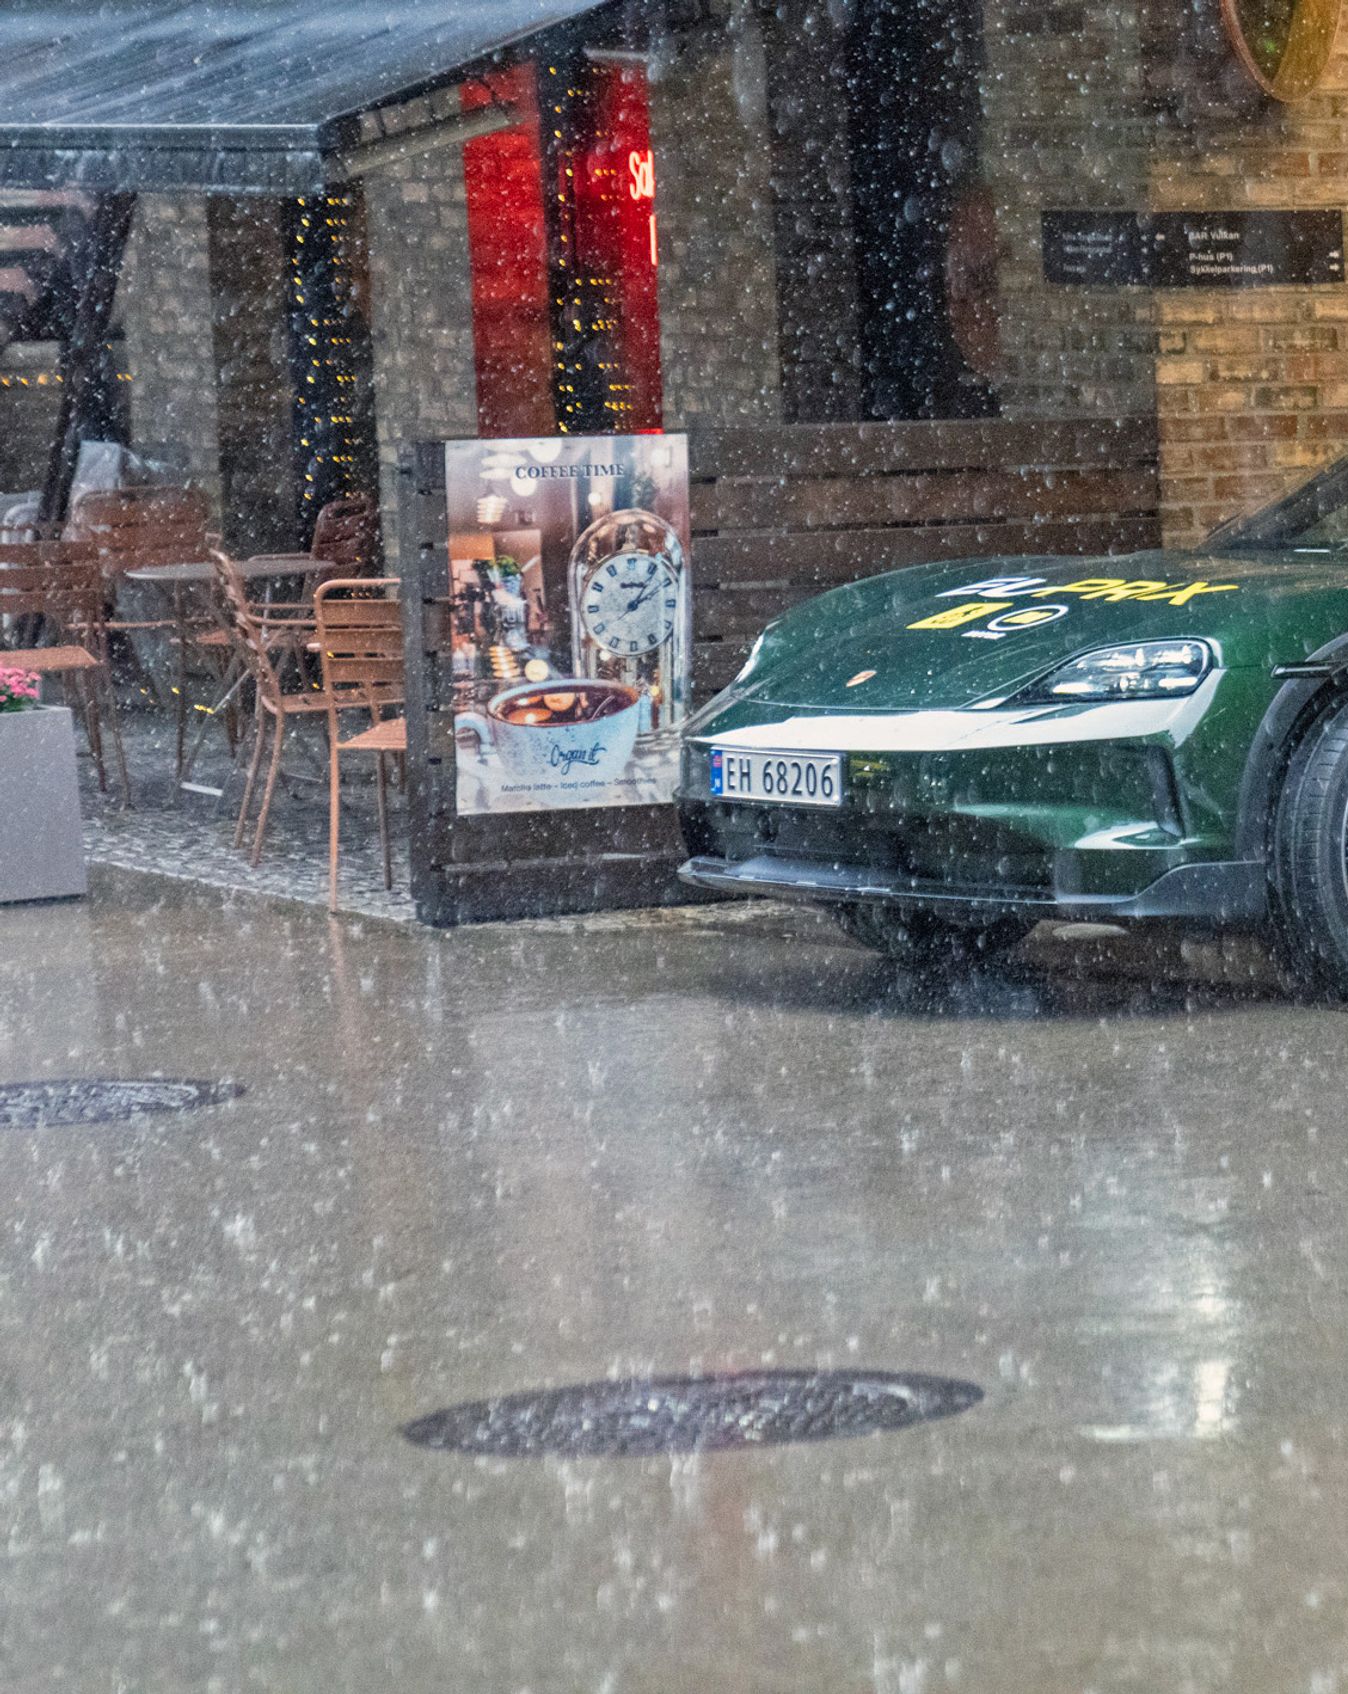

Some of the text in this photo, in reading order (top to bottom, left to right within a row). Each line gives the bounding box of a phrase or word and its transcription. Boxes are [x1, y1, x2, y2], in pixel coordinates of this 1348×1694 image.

[1210, 230, 1240, 240] Vulkan
[514, 463, 625, 480] COFFEE TIME
[726, 757, 834, 797] EH 68206
[579, 779, 606, 789] coffee
